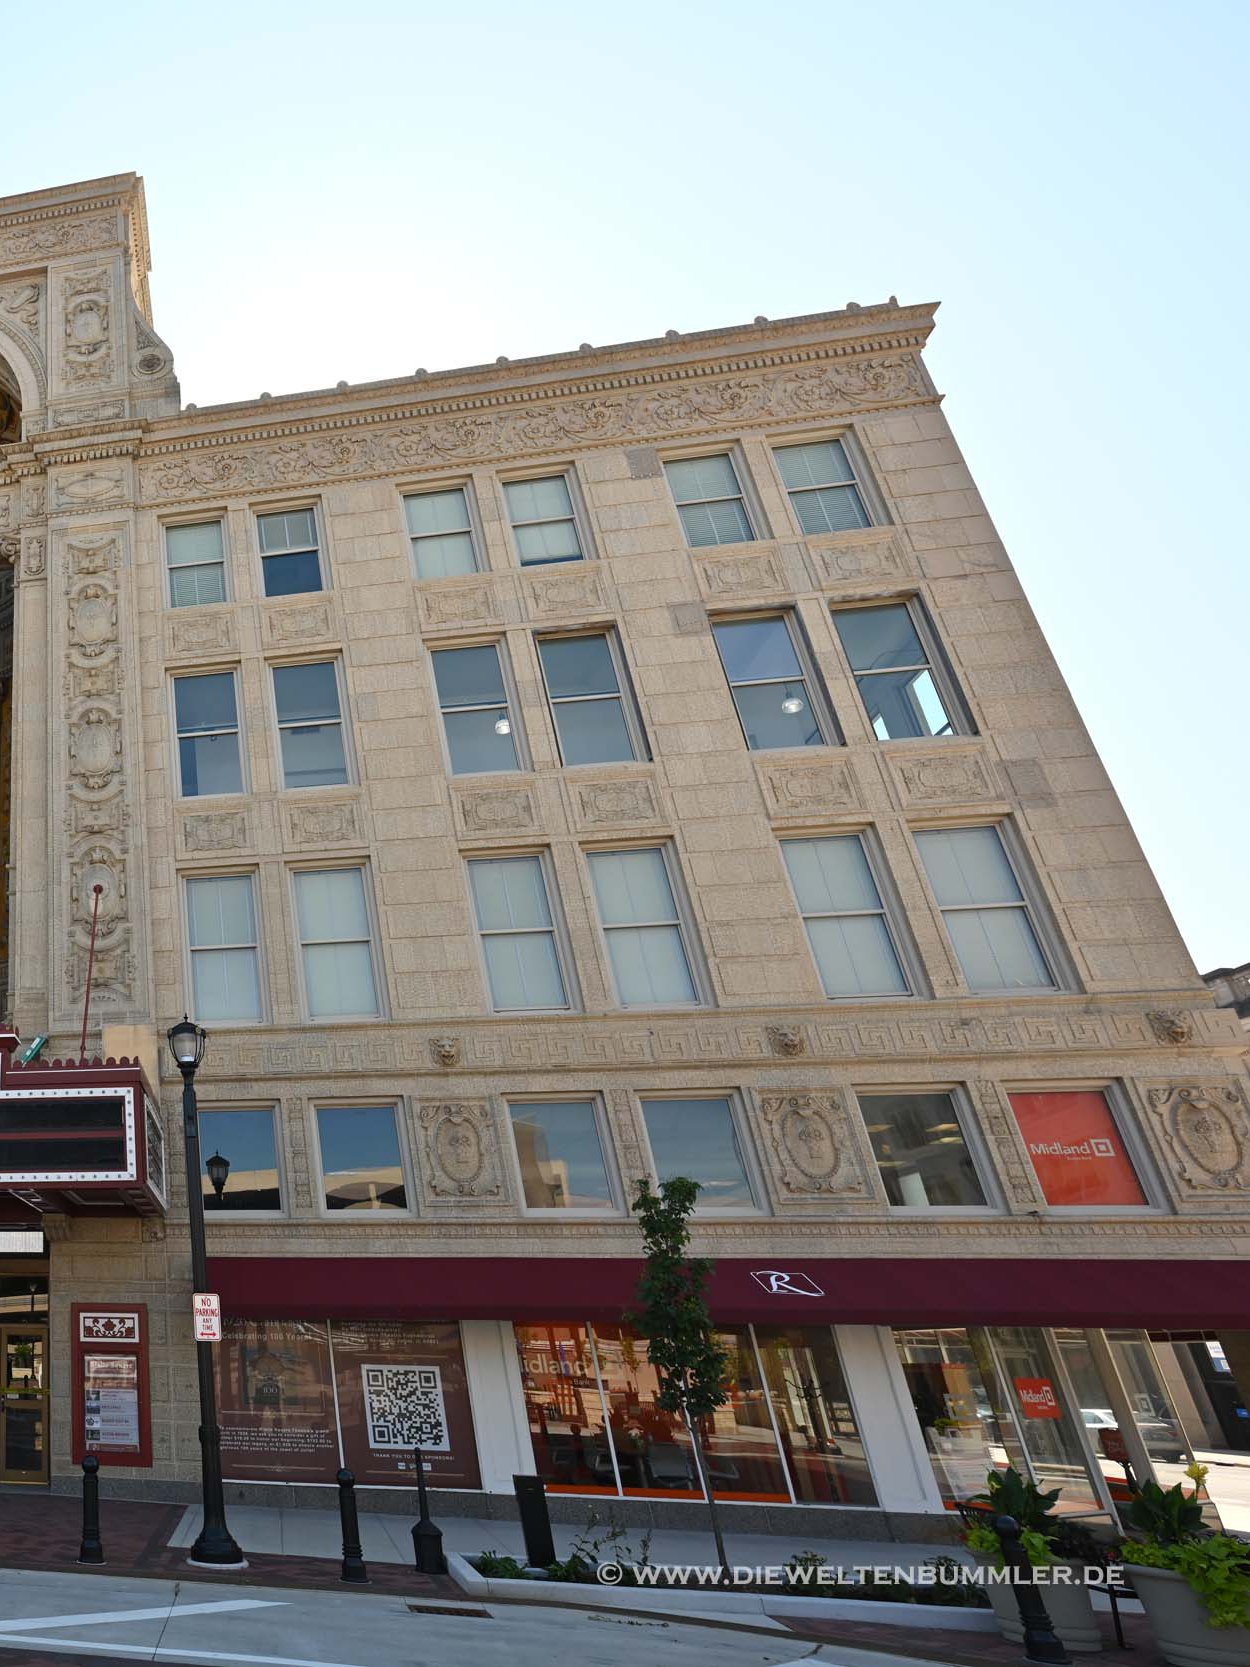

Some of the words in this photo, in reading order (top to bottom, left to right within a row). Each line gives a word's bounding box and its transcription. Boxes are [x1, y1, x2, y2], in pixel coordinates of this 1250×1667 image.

[1030, 1142, 1091, 1155] Midland
[201, 1297, 212, 1307] NO
[195, 1308, 218, 1318] PARKING
[1019, 1388, 1047, 1403] Midland
